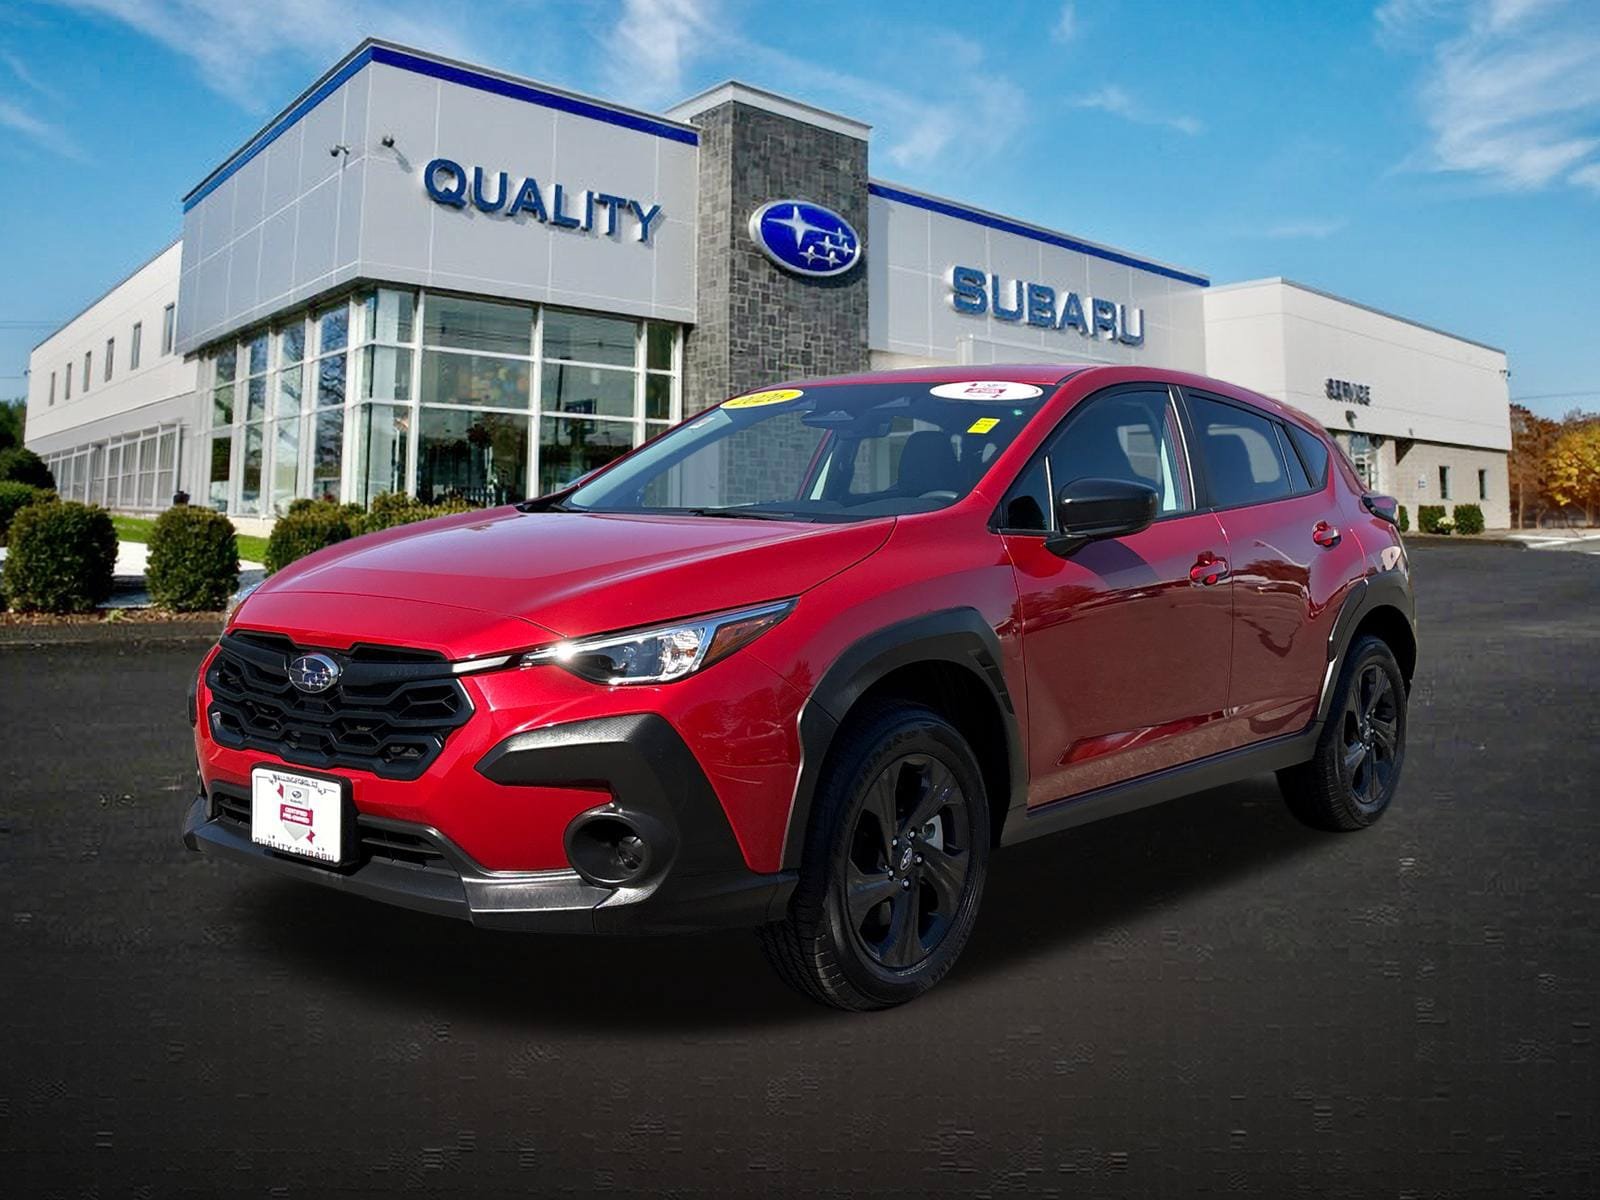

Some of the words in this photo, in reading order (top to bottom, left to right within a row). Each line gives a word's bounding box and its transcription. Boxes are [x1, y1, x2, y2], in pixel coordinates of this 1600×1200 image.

[424, 158, 661, 242] QUALITY
[948, 265, 1144, 346] SUBARU
[1325, 378, 1371, 406] SERVICE
[254, 837, 293, 851] QUALITY
[294, 847, 335, 861] SUBARU
